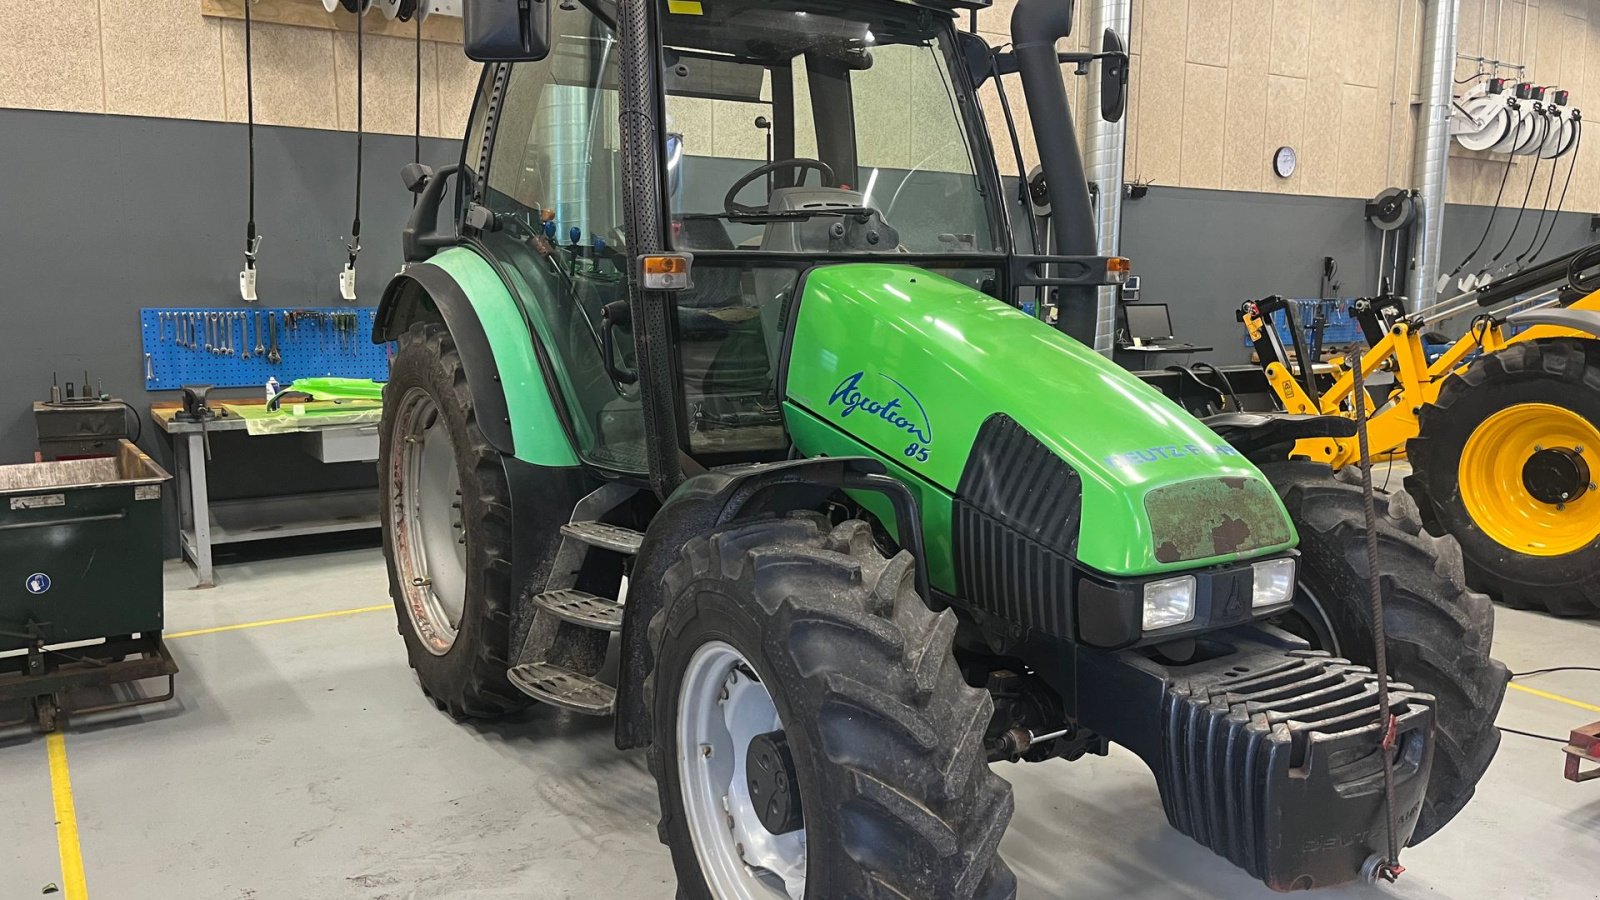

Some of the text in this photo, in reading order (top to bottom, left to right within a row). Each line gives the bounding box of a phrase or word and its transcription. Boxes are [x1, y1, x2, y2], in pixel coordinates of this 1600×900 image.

[829, 371, 932, 444] Agrotron
[904, 443, 932, 462] 85
[1104, 444, 1236, 468] DEUTZ-FHR
